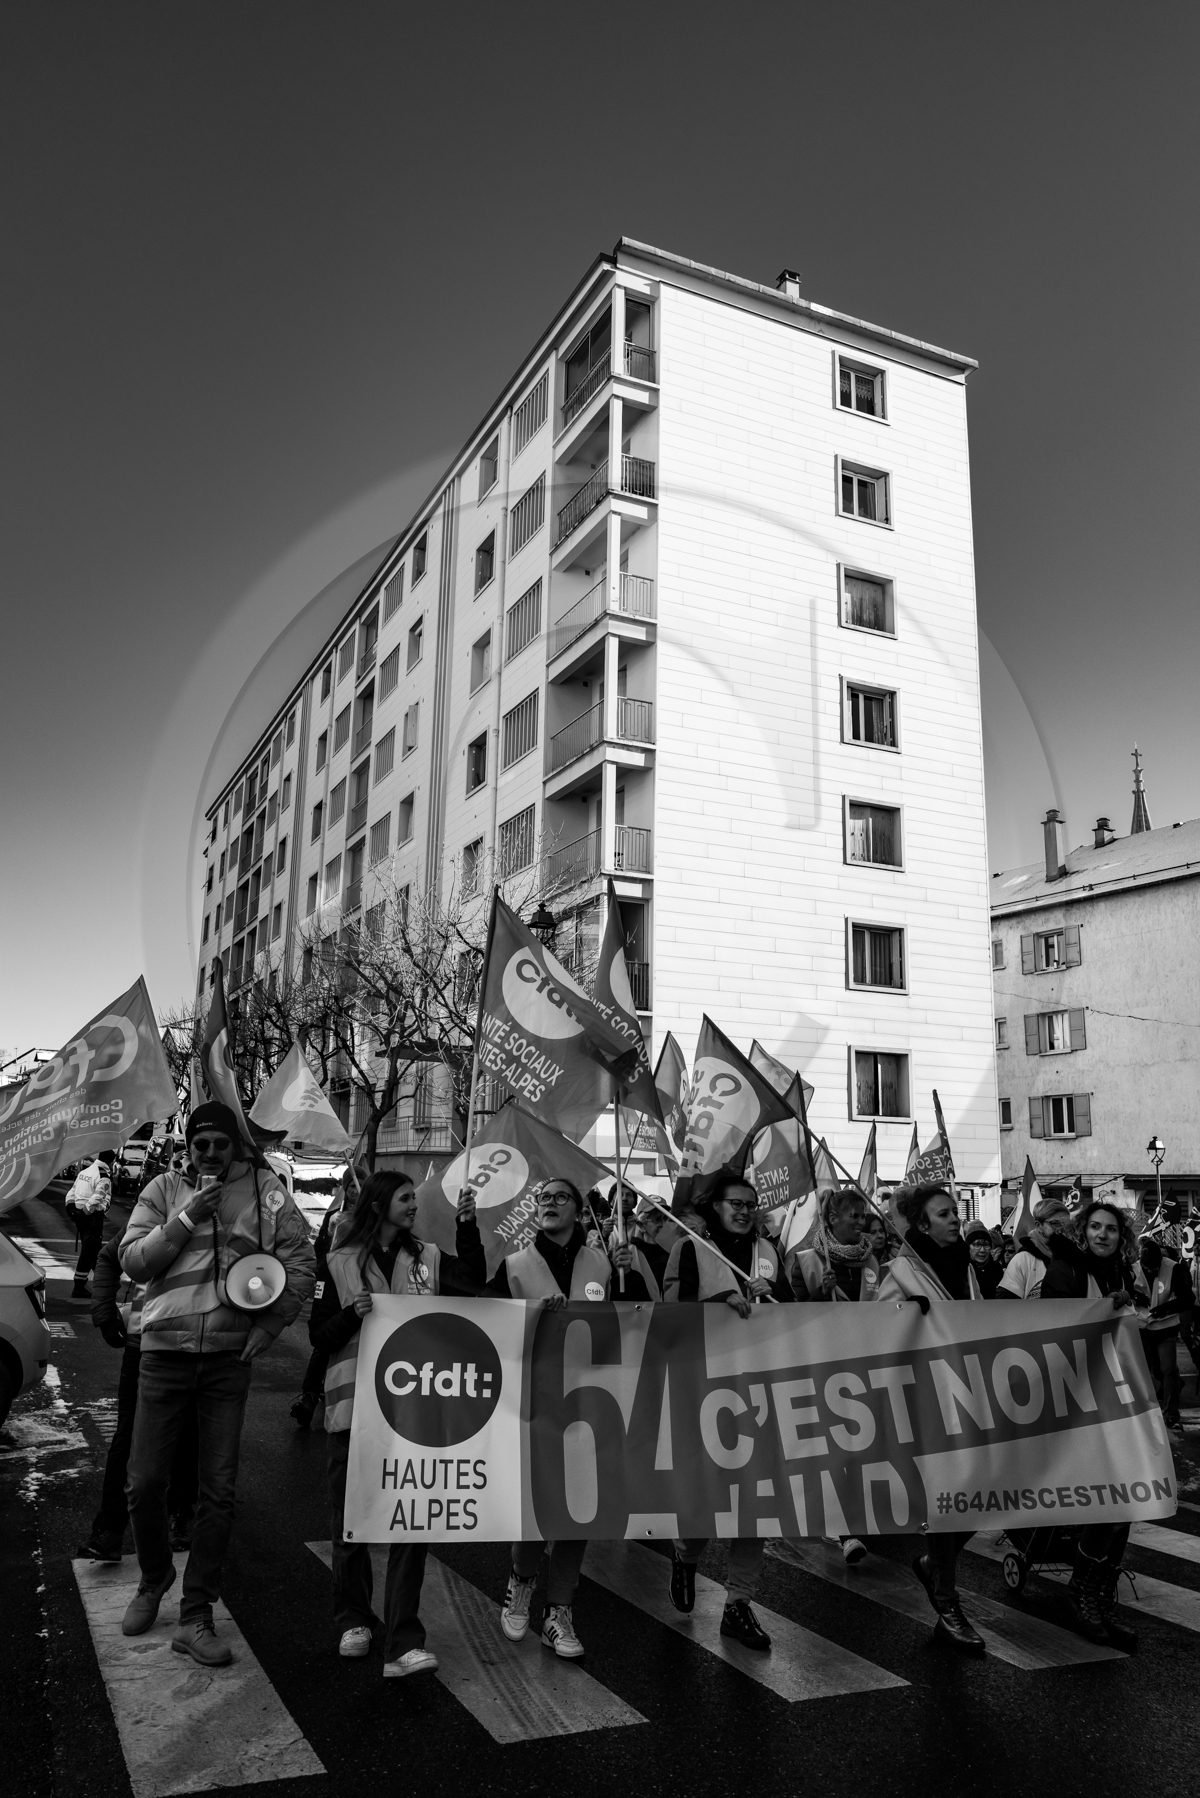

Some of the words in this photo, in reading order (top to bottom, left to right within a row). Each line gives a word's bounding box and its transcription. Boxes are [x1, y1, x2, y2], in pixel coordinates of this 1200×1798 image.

[504, 1032, 565, 1086] SOCIAUX
[383, 1360, 493, 1398] Cfdt:
[529, 1302, 730, 1540] 64
[700, 1364, 917, 1470] C'EST
[928, 1338, 1099, 1436] NON
[381, 1458, 488, 1490] HAUTES
[389, 1498, 478, 1531] ALPES
[936, 1477, 1173, 1514] #64ANSCESTNON
